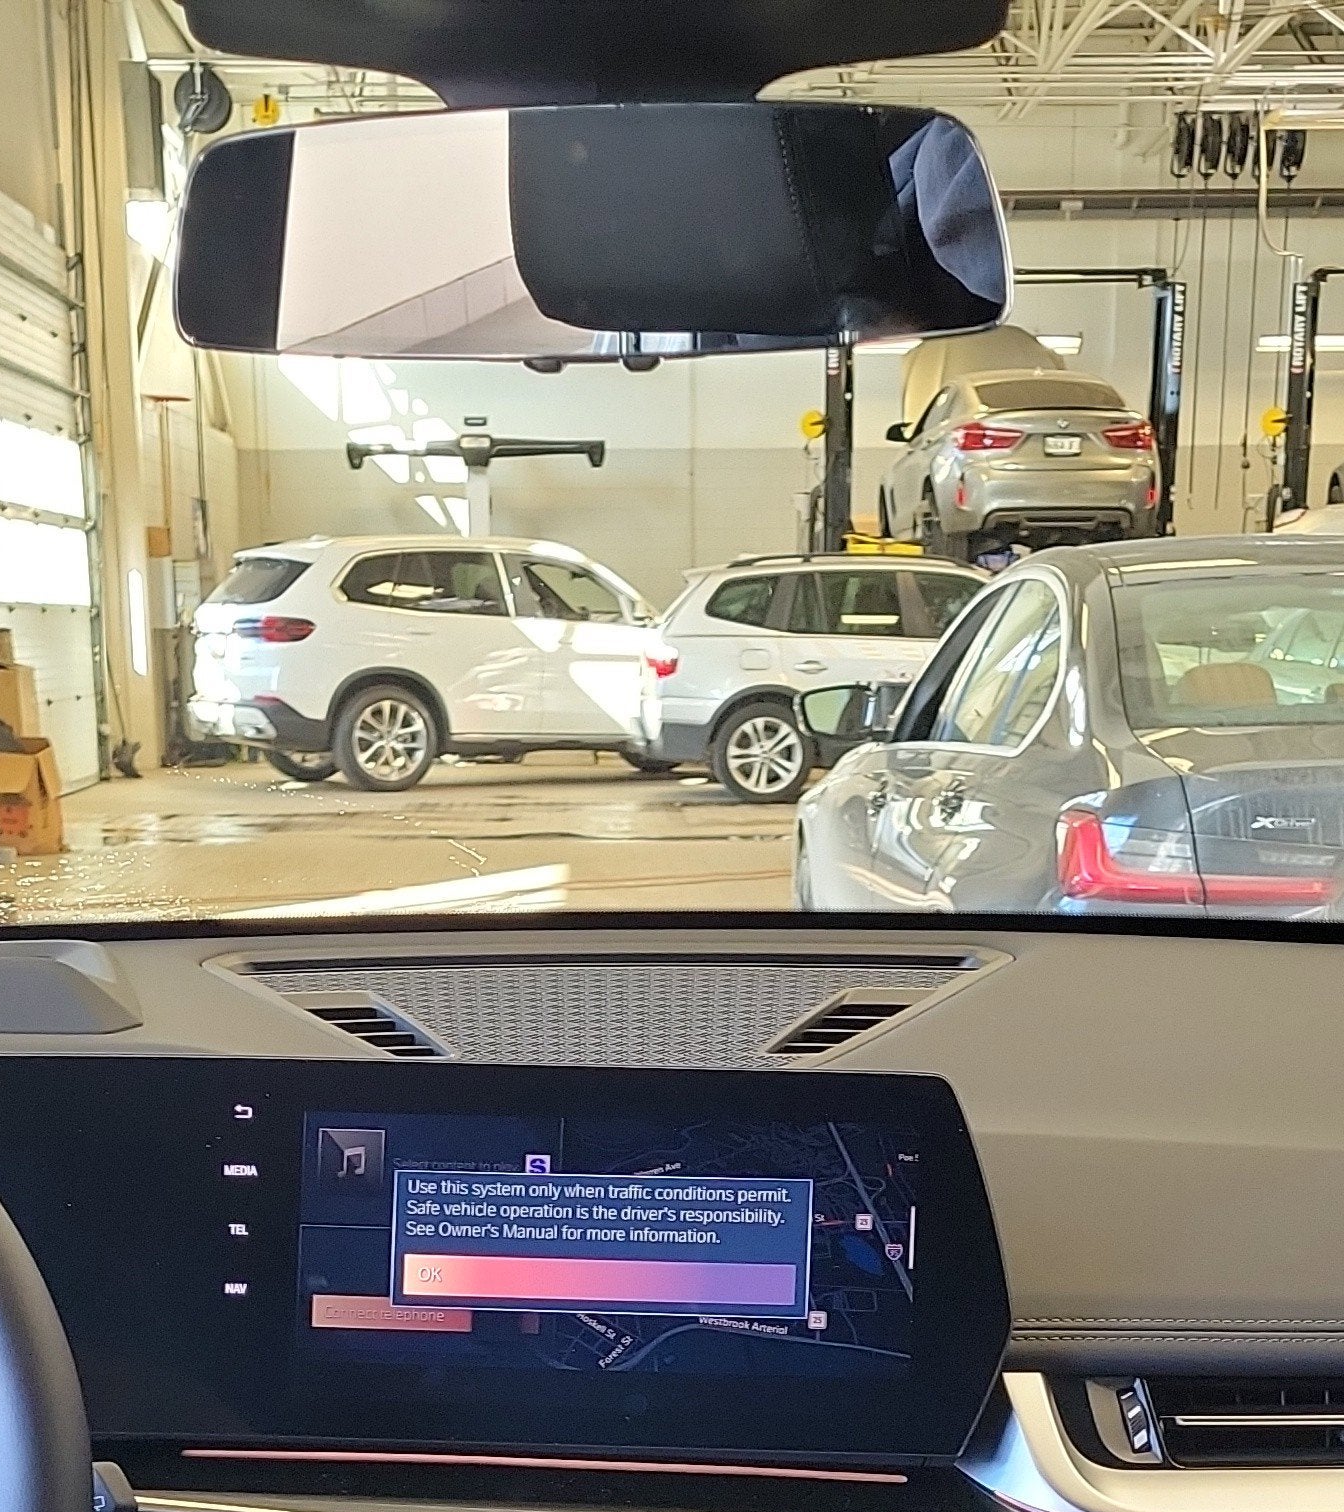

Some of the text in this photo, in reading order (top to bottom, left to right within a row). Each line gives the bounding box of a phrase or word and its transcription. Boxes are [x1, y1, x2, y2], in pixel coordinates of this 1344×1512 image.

[1292, 285, 1308, 366] ROTARY LIFT
[223, 1164, 258, 1176] MEDIA
[665, 1162, 682, 1172] Ave
[408, 1179, 792, 1204] Use this system only when traffic conditions permit.
[406, 1200, 785, 1227] Safe vehicle operation is the driver's responsibility.
[228, 1224, 249, 1236] TEL
[405, 1221, 721, 1244] See Owner's Manual for more information.
[417, 1266, 443, 1282] OK
[224, 1283, 248, 1295] NAV
[698, 1315, 789, 1335] Westbrook Arterial
[598, 1342, 626, 1369] Forest
